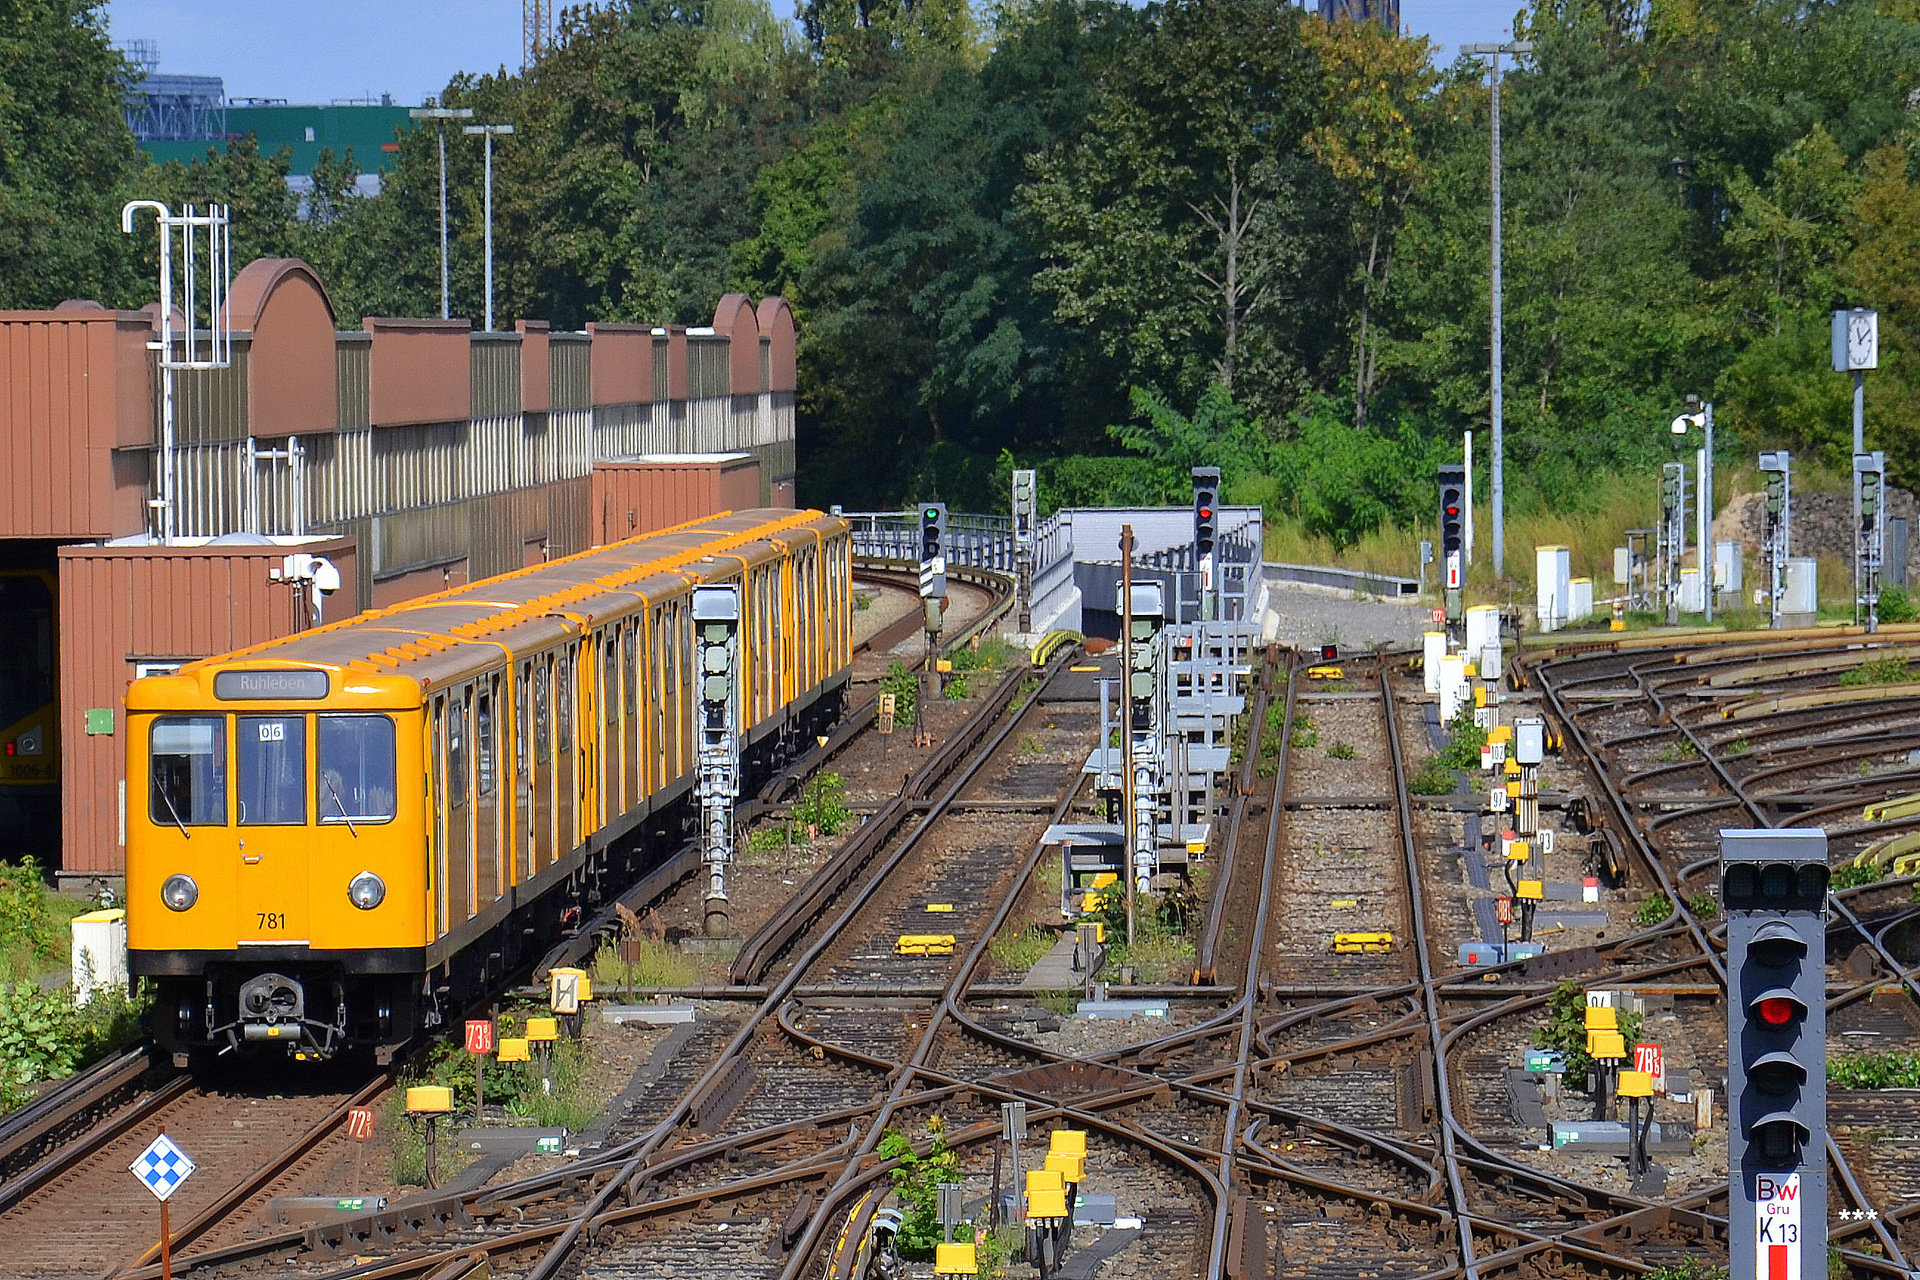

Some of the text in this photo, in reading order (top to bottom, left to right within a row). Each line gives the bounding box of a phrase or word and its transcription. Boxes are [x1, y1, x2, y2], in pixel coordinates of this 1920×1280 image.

[240, 675, 305, 690] Ruhleben
[261, 726, 281, 739] 06
[1493, 792, 1503, 807] 97
[256, 912, 285, 930] 781
[1757, 1178, 1798, 1201] Bw
[1766, 1203, 1790, 1215] Gru
[1760, 1216, 1797, 1243] K 13
